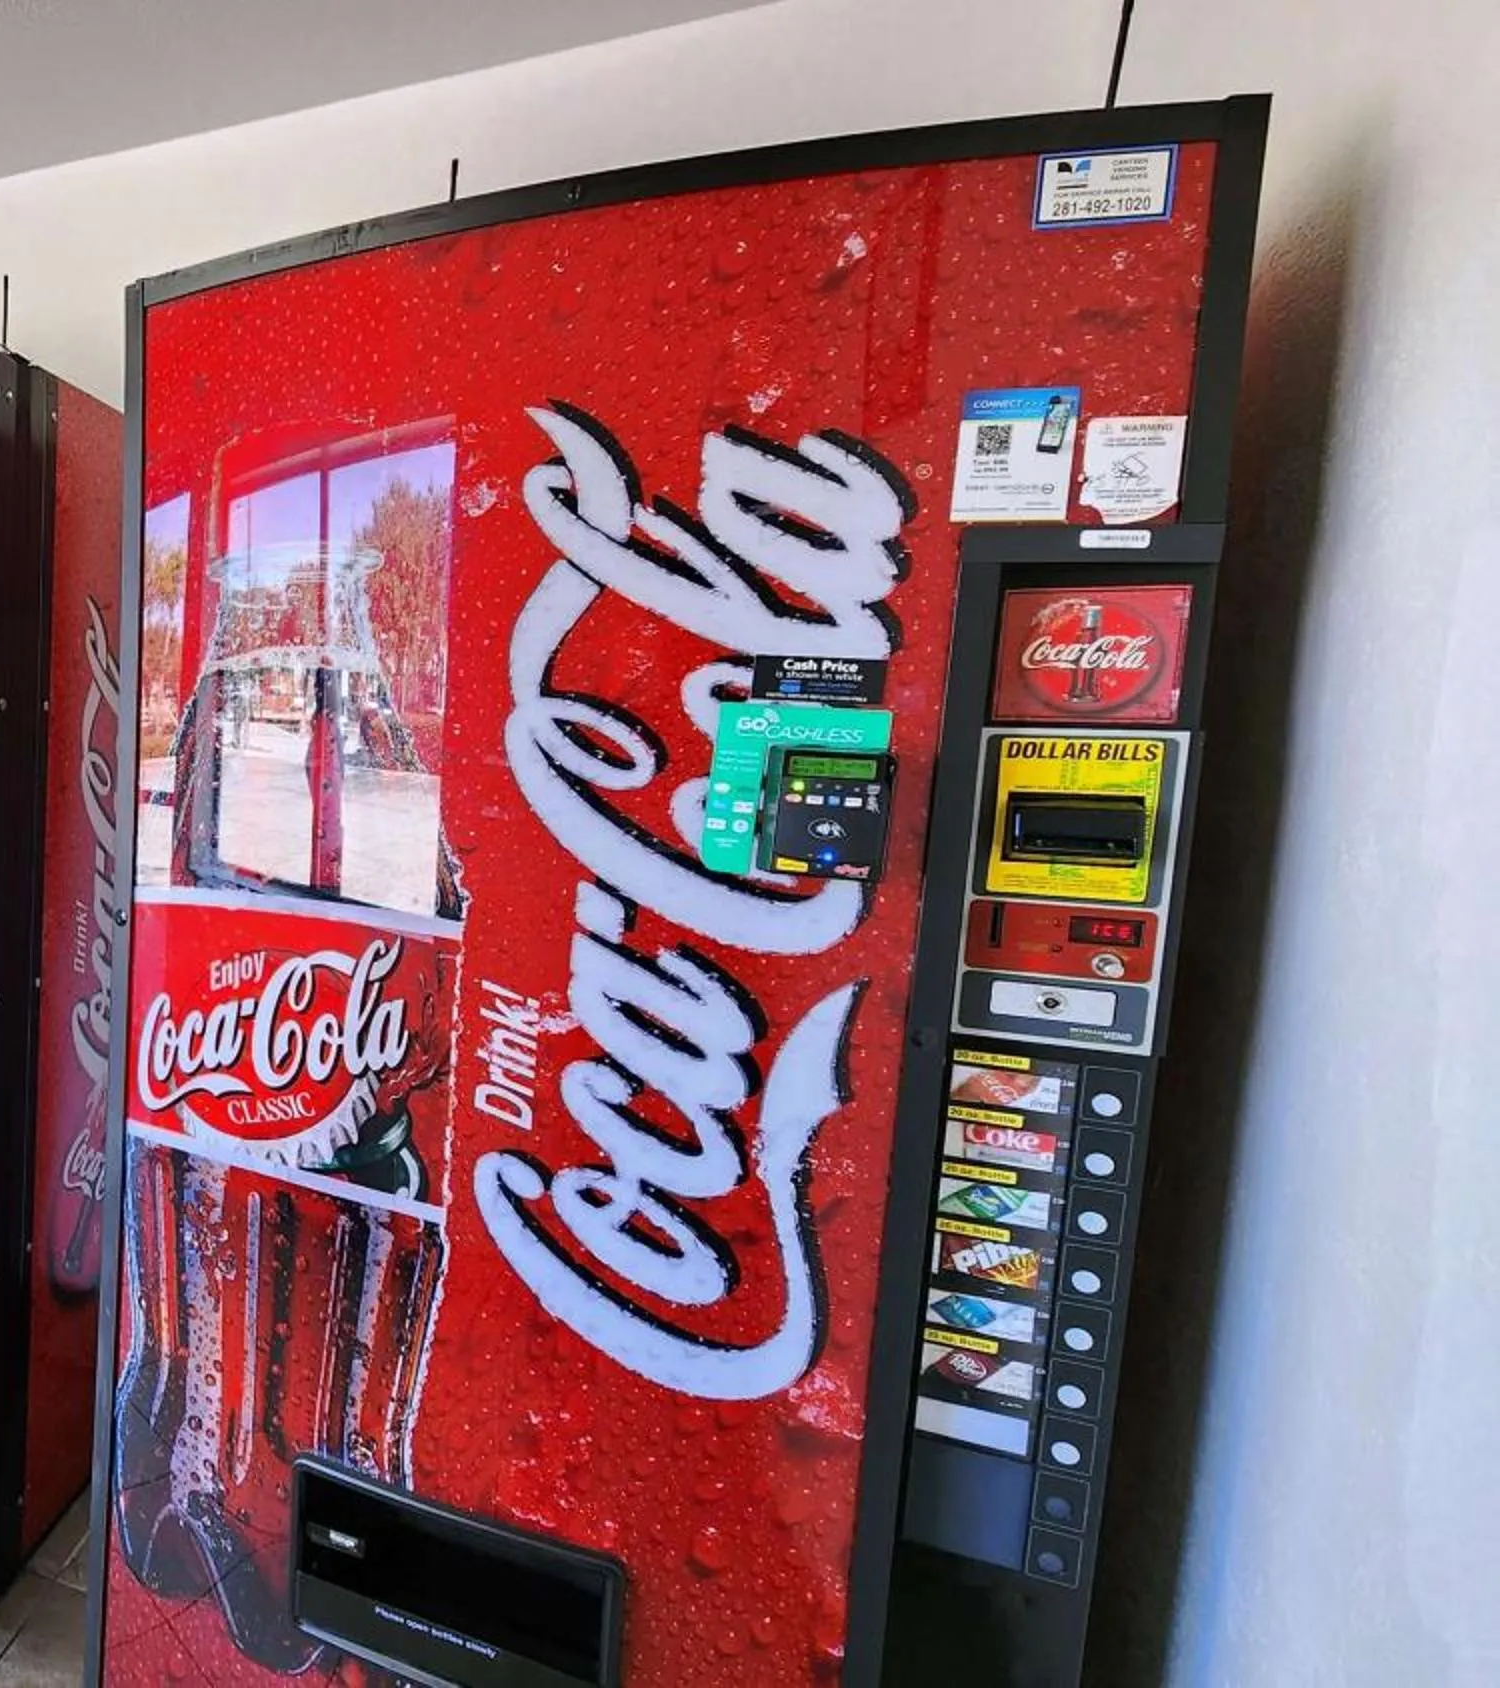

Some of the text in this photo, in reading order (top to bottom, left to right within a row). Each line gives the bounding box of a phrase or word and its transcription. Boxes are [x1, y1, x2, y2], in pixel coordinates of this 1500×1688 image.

[1052, 195, 1152, 217] 281-492-1020
[783, 658, 859, 674] Cash Price
[1021, 633, 1157, 671] Coca-Cola
[775, 669, 865, 683] is shown in white
[737, 716, 865, 744] GO CASHLESS
[1007, 741, 1160, 762] DOLLAR BILLS
[474, 404, 902, 1400] Coca-Cla
[73, 900, 90, 974] Drink!
[209, 951, 266, 991] Enjoy
[137, 935, 409, 1111] Coca-Cola
[475, 979, 540, 1131] Drink!
[227, 1091, 316, 1125] CLASSIC
[966, 1123, 1040, 1153] Coke
